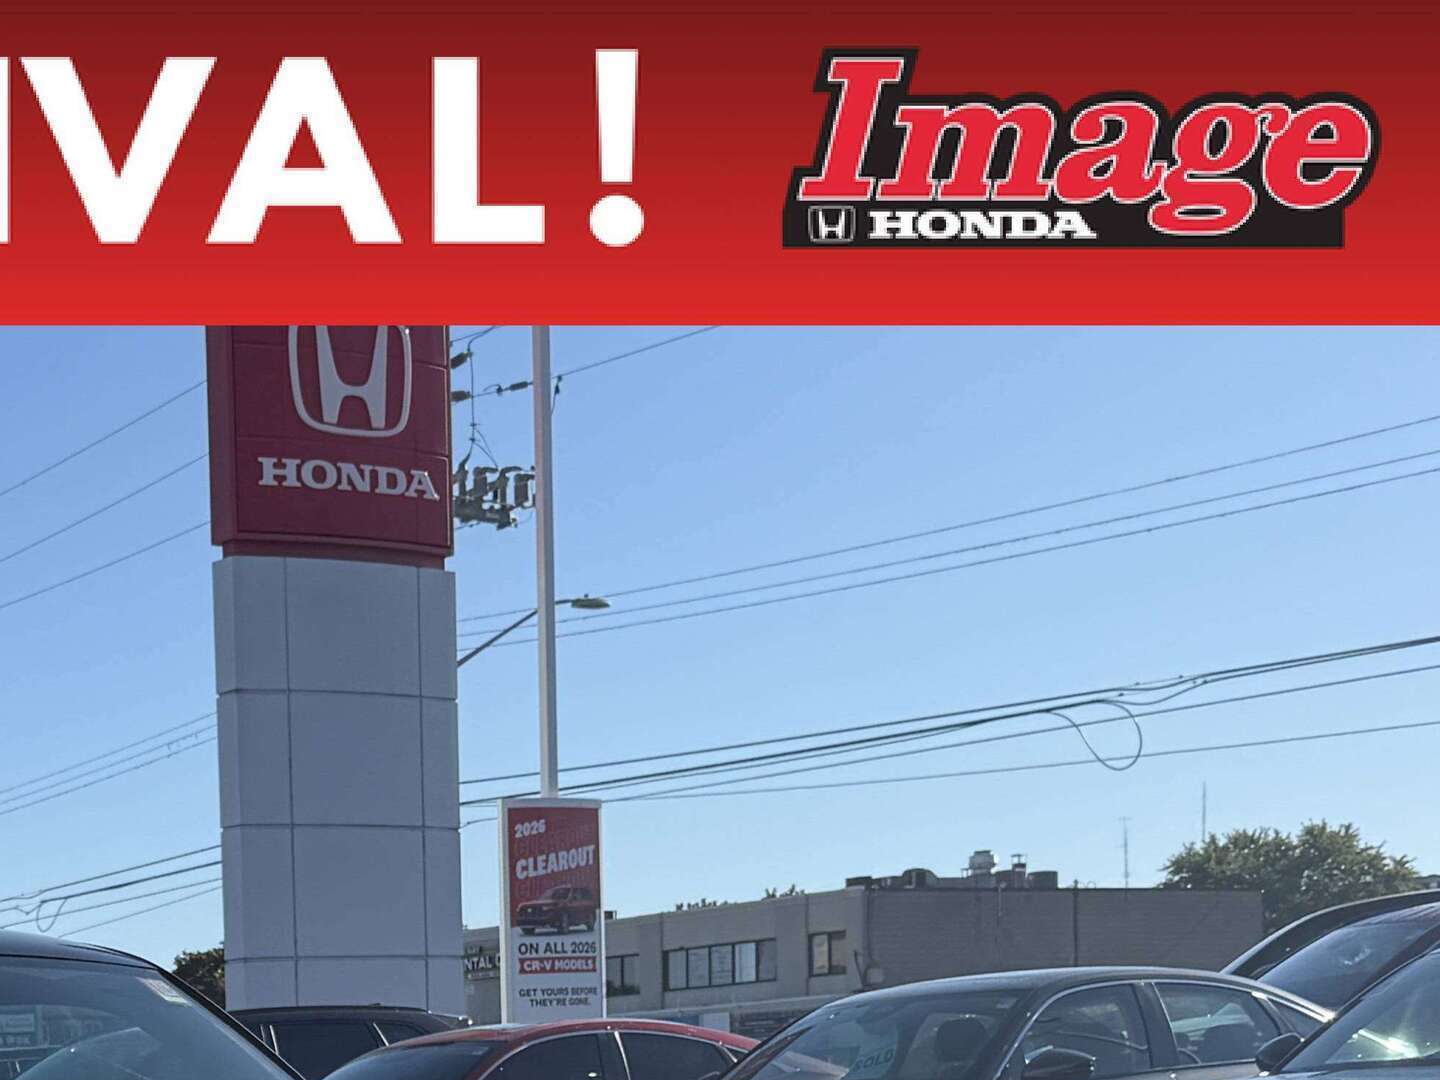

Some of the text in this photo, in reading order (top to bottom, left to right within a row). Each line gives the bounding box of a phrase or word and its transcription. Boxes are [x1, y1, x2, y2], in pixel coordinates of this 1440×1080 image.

[257, 456, 440, 501] HONDA
[514, 818, 546, 838] 2026
[515, 844, 595, 880] CLEAROUT
[518, 941, 596, 956] ON ALL 2026
[523, 958, 593, 971] CR-V MODELS
[518, 986, 598, 997] GET YOURS BEFORE
